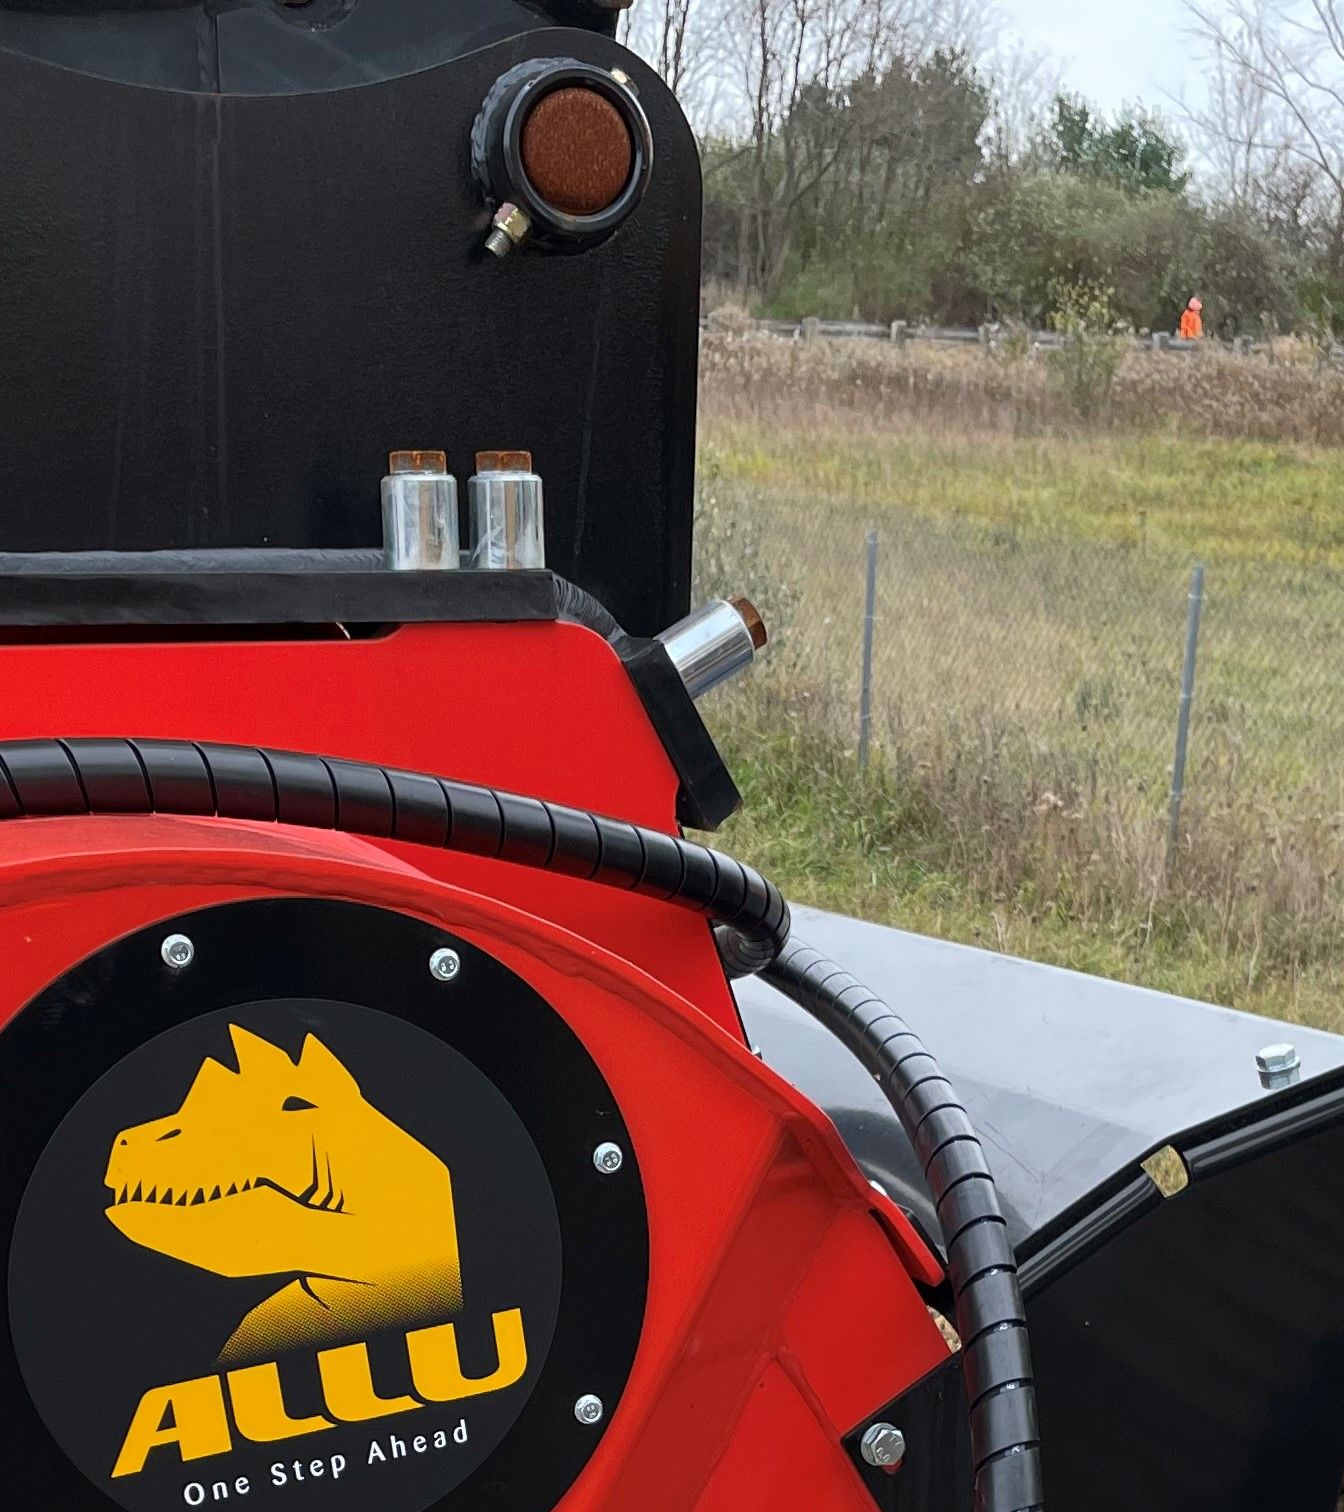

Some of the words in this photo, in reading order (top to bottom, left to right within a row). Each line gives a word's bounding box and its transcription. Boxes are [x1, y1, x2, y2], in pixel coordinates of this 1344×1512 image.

[111, 1307, 528, 1478] ALLU
[183, 1476, 250, 1506] One
[270, 1454, 346, 1486] Step
[367, 1419, 469, 1464] Ahead
